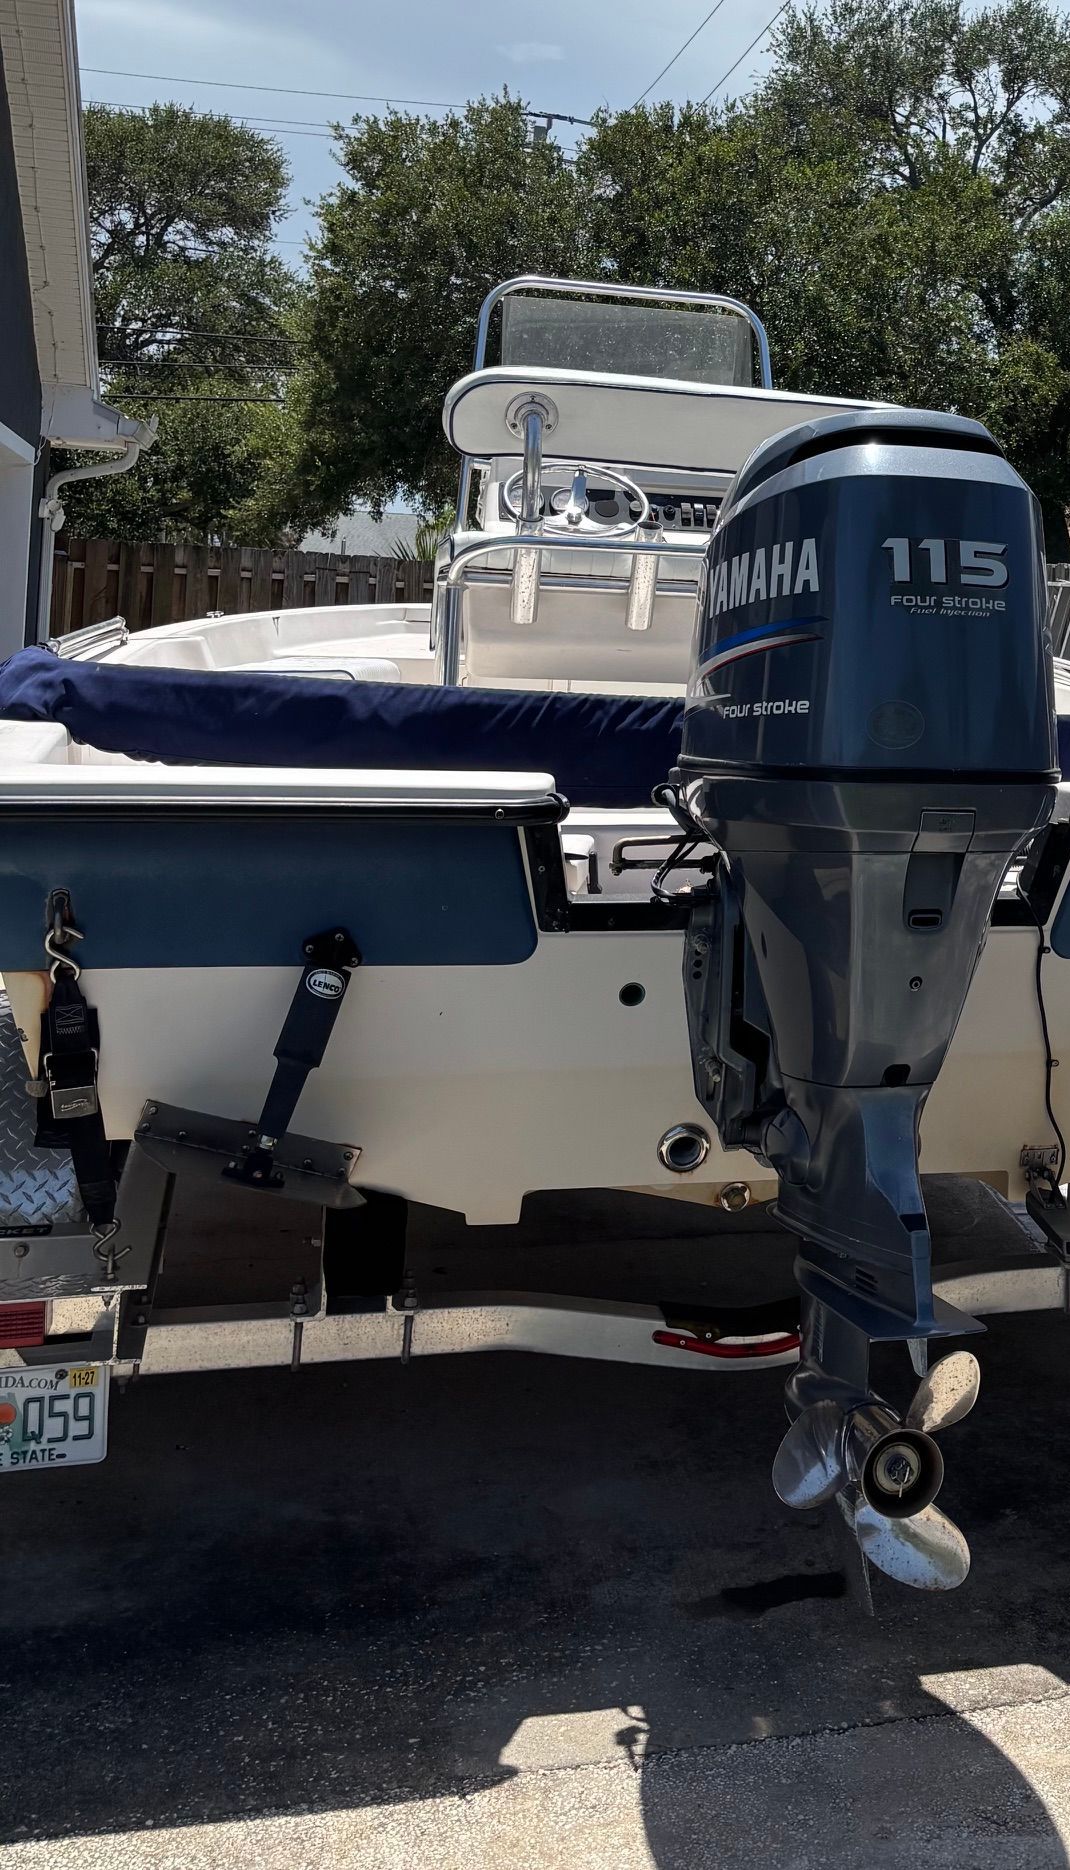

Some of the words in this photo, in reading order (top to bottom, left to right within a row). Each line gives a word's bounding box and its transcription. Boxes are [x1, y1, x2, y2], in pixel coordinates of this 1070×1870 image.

[880, 537, 1009, 588] 115
[709, 537, 820, 619] YAMAHA
[910, 607, 937, 615] Fuel
[940, 608, 991, 618] Injection
[312, 979, 340, 993] LENCO
[72, 1371, 95, 1387] 11-27
[22, 1392, 95, 1444] Q59
[10, 1448, 56, 1465] STATE
